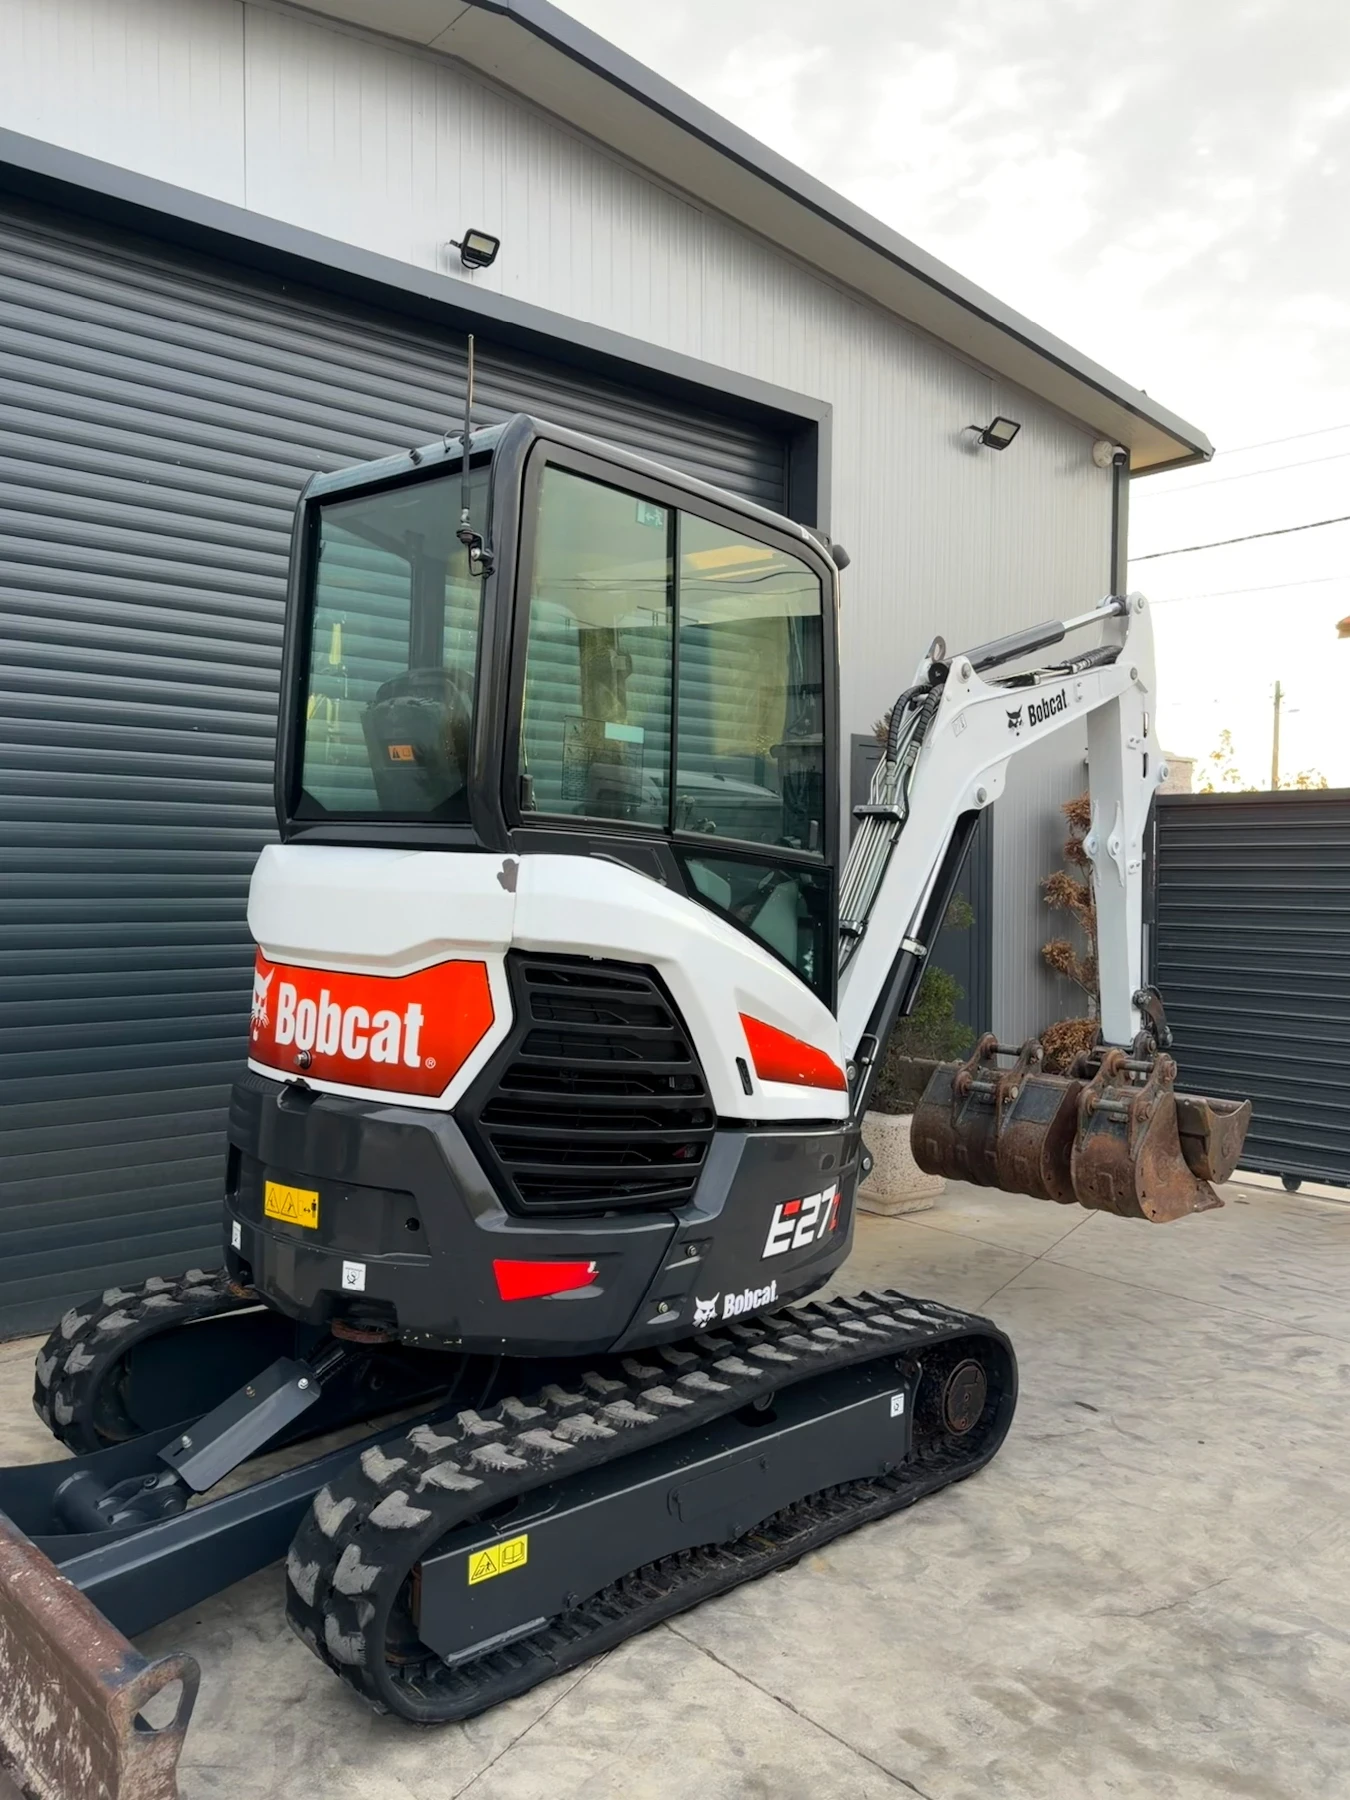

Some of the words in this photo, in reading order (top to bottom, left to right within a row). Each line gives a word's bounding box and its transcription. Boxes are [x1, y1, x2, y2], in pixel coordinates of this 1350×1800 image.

[1027, 688, 1067, 727] Bobcat
[274, 981, 424, 1068] Bobcat
[722, 1280, 777, 1320] Bobcat
